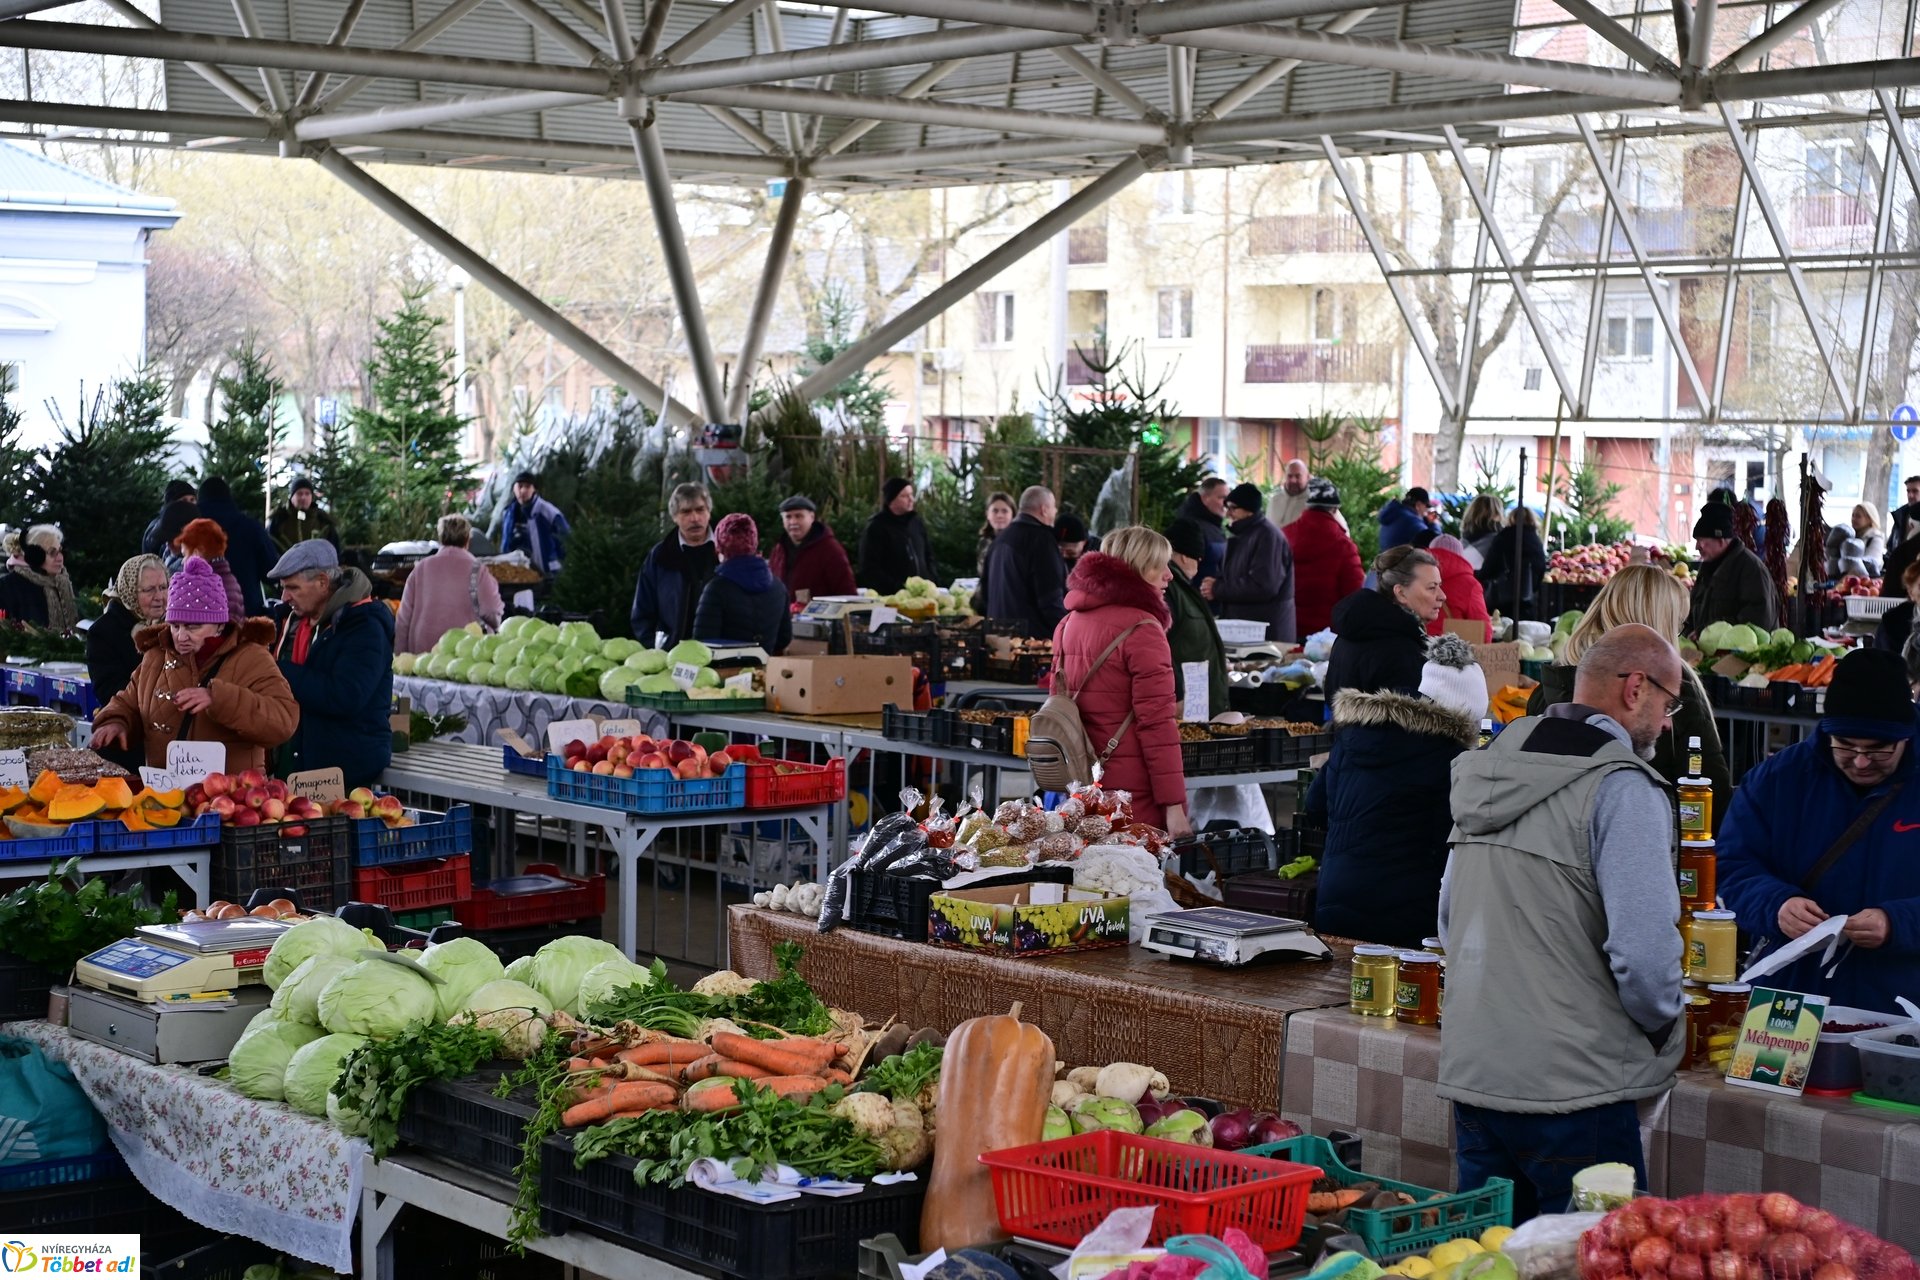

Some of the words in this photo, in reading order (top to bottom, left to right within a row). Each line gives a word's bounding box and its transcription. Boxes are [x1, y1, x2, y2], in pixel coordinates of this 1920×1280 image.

[970, 914, 992, 931] UVA
[1079, 906, 1105, 925] UVA
[1095, 922, 1104, 933] da
[1105, 917, 1125, 936] tavola
[983, 931, 992, 940] da
[992, 931, 1009, 944] tavola
[1769, 1017, 1794, 1030] 100%
[1744, 1028, 1811, 1055] Méhpempő
